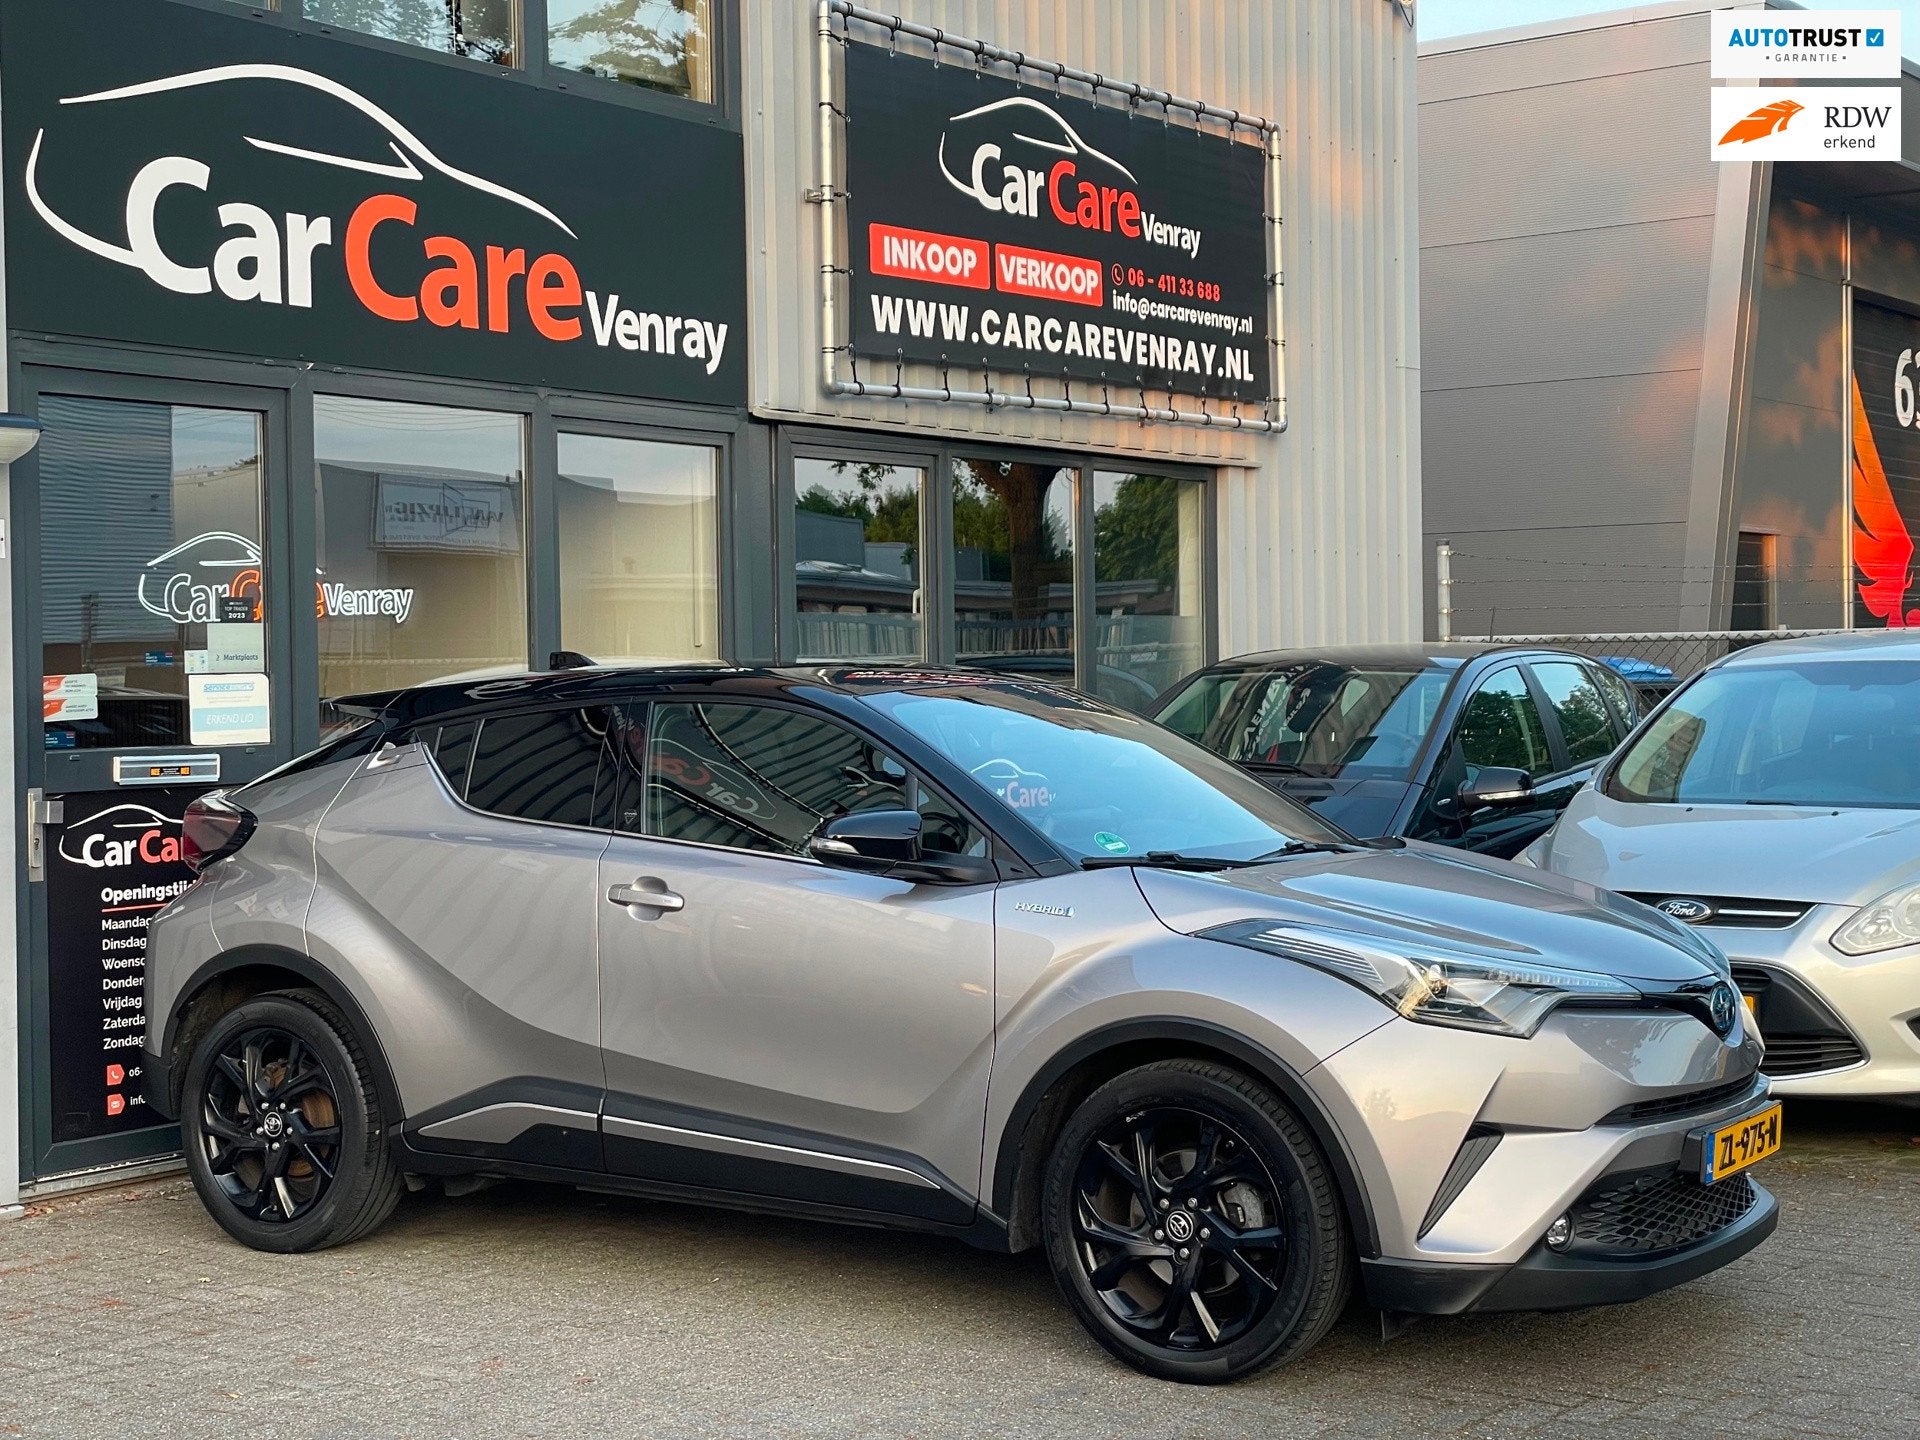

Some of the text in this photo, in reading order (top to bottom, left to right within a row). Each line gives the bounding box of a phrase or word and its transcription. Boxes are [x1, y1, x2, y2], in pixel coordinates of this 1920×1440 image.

[1141, 211, 1201, 259] Venray
[883, 235, 978, 278] INKOOP
[1000, 253, 1099, 297] VERKOOP
[1127, 267, 1145, 287] 06
[1158, 274, 1176, 294] 411
[1179, 277, 1194, 297] 33
[1197, 281, 1221, 302] 688
[585, 290, 729, 376] Venray
[1112, 289, 1253, 337] info@carcarevenray.nl
[870, 294, 1254, 382] WWW.CARCAREVENRAY.NL
[1894, 348, 1920, 430] 6
[323, 583, 413, 624] Venray
[1015, 902, 1065, 916] HYBRID
[1665, 901, 1697, 916] Ford
[102, 936, 147, 951] Dinsdag
[103, 976, 144, 990] Donder
[103, 996, 143, 1011] Vrijdag
[103, 1014, 146, 1030] Zaterda
[1719, 1114, 1778, 1171] ZL-975-N
